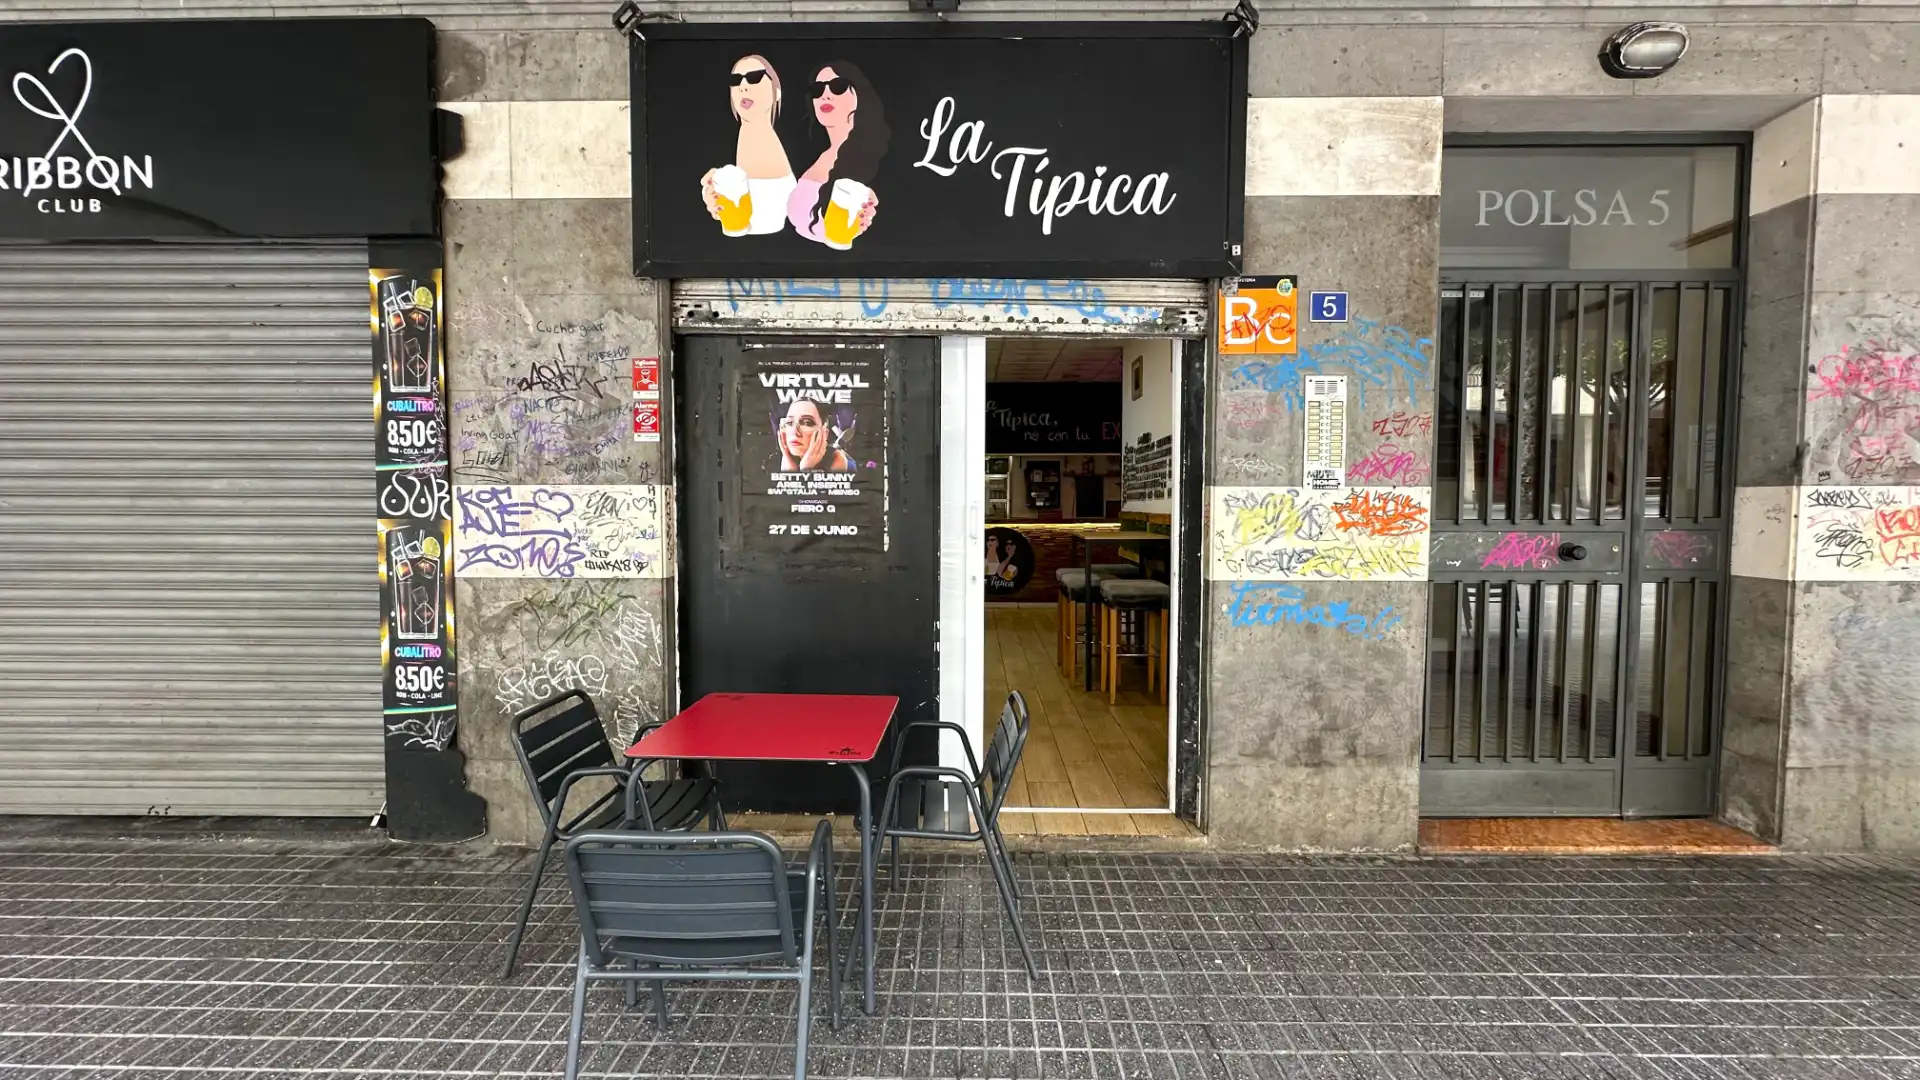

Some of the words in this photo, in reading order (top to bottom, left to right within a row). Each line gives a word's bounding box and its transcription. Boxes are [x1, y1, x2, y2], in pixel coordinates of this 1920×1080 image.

[913, 96, 993, 177] La
[991, 144, 1178, 235] Típica
[37, 198, 102, 213] CLUB
[1475, 189, 1635, 227] POLSA
[1648, 189, 1671, 227] 5
[1321, 296, 1338, 318] 5
[758, 372, 870, 388] VIRTUAL
[776, 388, 853, 404] WAVE
[387, 400, 434, 412] CUBALITRO
[771, 473, 810, 481] BETTY
[813, 473, 856, 482] BUNNY
[807, 481, 851, 489] INSERTE
[791, 504, 824, 513] FIERO
[826, 505, 836, 513] G
[768, 524, 787, 535] 27
[790, 525, 810, 535] DE
[813, 525, 858, 535] JUNIO
[395, 646, 441, 658] CUBALITRO
